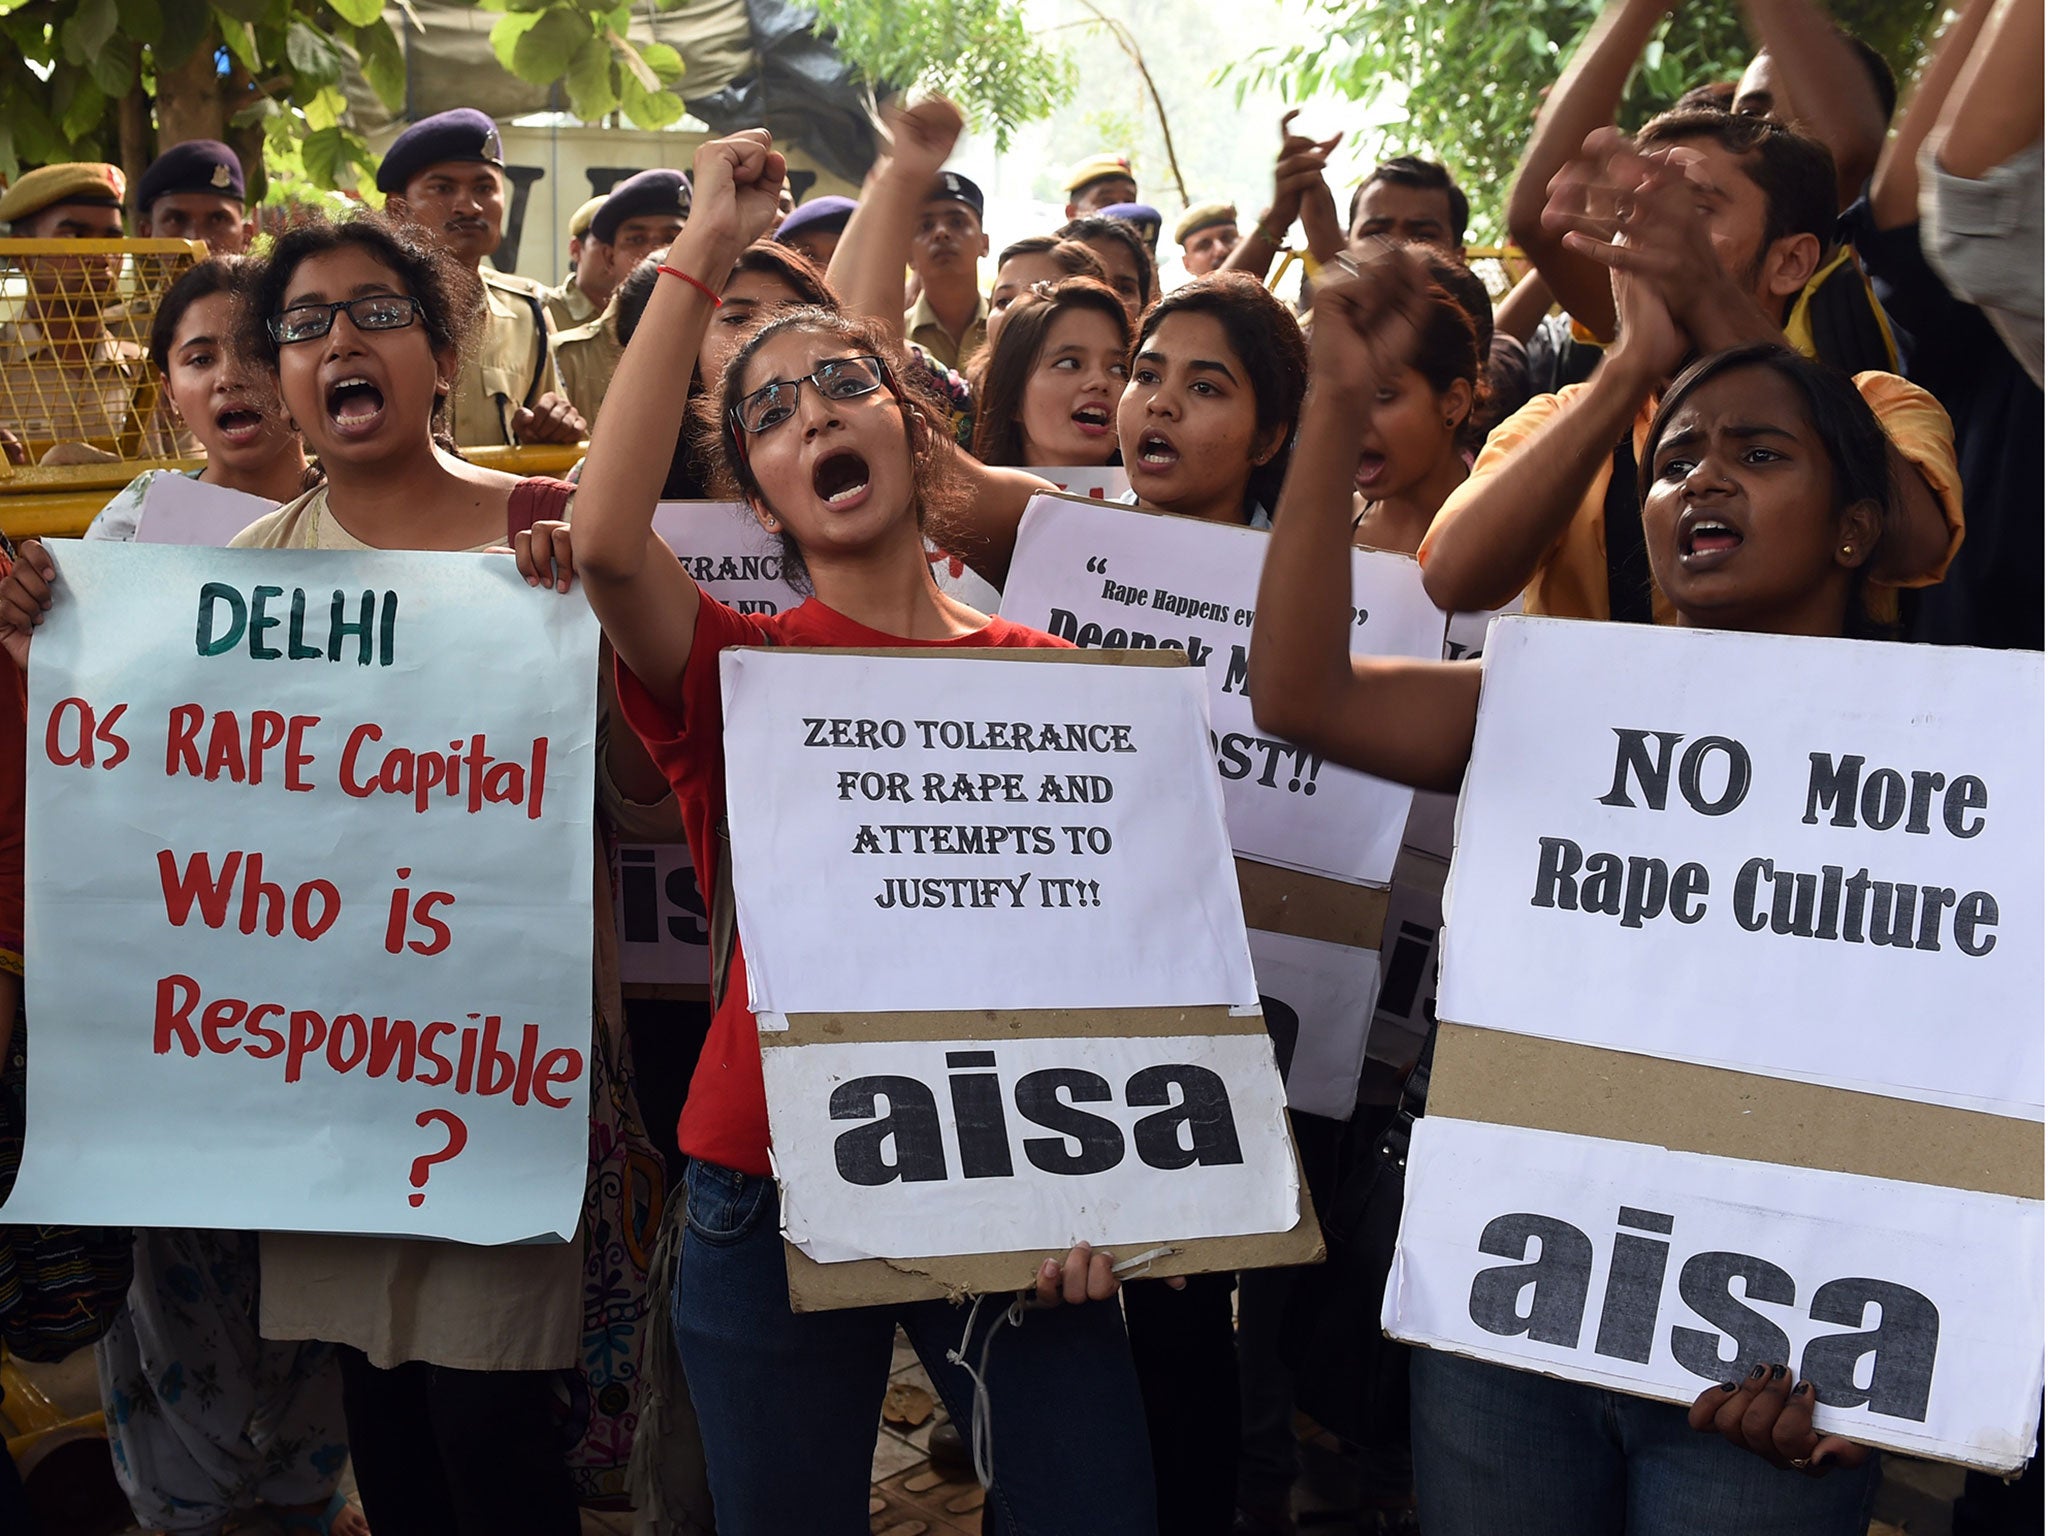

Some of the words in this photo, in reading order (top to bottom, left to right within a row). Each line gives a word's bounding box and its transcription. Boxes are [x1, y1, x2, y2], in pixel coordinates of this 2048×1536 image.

[195, 582, 398, 668] DELHI
[1048, 608, 1213, 667] Deek
[1101, 579, 1149, 607] Rape
[1151, 588, 1230, 623] Happens
[166, 703, 321, 792] RAPE
[339, 723, 549, 820] Capital
[803, 718, 906, 751] ZERO
[913, 720, 1138, 754] TOLERANCE
[1595, 727, 1752, 817] NO
[1801, 752, 1988, 839] More
[837, 771, 914, 804] FOR
[918, 772, 1029, 804] RAPE
[1036, 774, 1114, 804] AND
[851, 824, 1056, 855] ATTEMPTS
[1060, 826, 1112, 855] TO
[157, 850, 341, 941] Who
[385, 867, 455, 956] is
[874, 872, 1032, 909] JUSTIFY
[1037, 879, 1101, 909] IT!!
[1530, 836, 1710, 929] Rape
[1733, 857, 1999, 957] Culture
[154, 974, 583, 1109] Responsible
[409, 1109, 468, 1208] ?
[828, 1050, 1245, 1187] aisa
[1468, 1205, 1940, 1424] aisa
